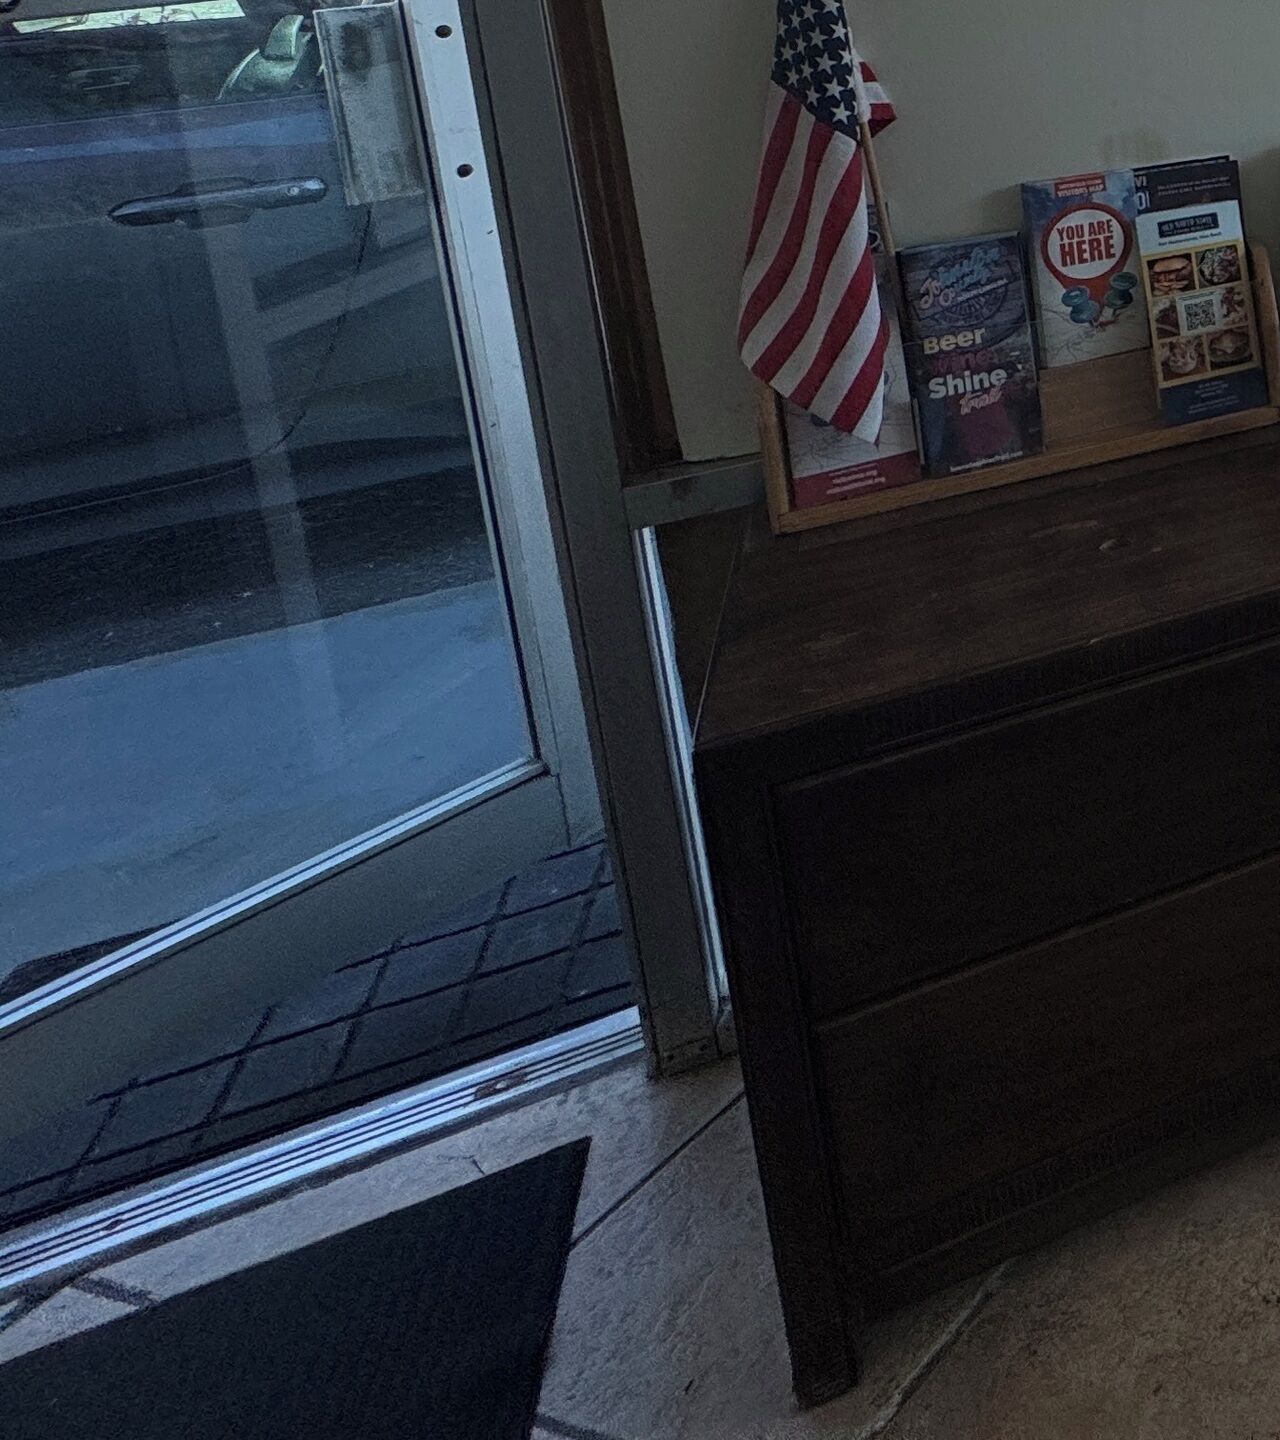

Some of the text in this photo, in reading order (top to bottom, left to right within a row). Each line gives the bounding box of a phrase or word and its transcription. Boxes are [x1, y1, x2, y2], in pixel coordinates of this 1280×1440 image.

[1056, 219, 1114, 242] YOU ARE
[1059, 235, 1116, 267] HERE
[923, 326, 985, 355] Beer
[928, 368, 1007, 399] Shine
